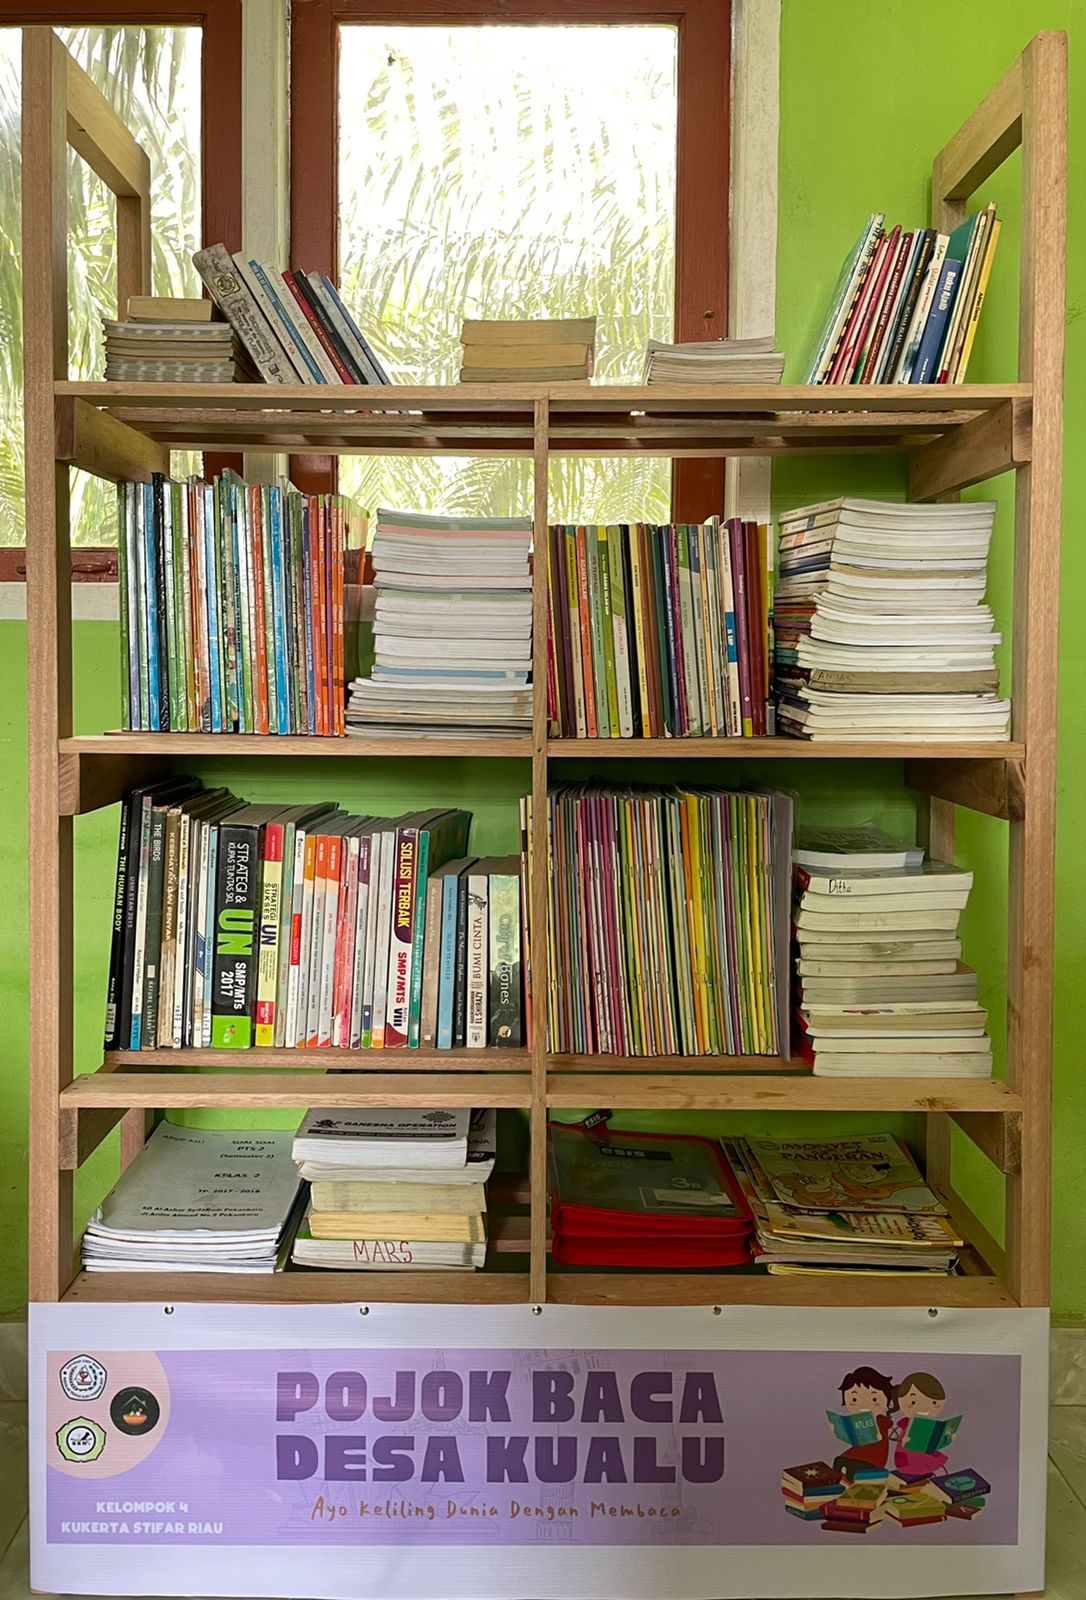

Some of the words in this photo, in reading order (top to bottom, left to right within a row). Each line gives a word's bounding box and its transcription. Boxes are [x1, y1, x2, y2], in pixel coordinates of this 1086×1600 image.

[942, 270, 956, 291] Buku
[936, 290, 951, 311] Ajaib
[153, 824, 162, 838] THE
[152, 839, 162, 862] BIRDS
[168, 832, 176, 881] KESEHATAN
[227, 842, 236, 864] KUPAS
[400, 842, 413, 879] SOLUSI
[118, 856, 127, 873] THE
[235, 843, 249, 892] STRATEGI
[116, 874, 126, 906] HUMAN
[226, 865, 235, 892] TUNTAS
[225, 892, 234, 904] SKL
[235, 894, 247, 904] &
[270, 882, 278, 921] STRATEGI
[397, 882, 411, 928] TERBAIK
[114, 908, 122, 933] BODY
[217, 909, 254, 956] UN
[496, 914, 514, 944] City
[261, 924, 277, 946] UN
[472, 917, 483, 951] CINTA
[395, 952, 407, 1004] SMP/MTS
[472, 952, 482, 980] BUMI
[220, 971, 234, 997] 2017
[233, 962, 247, 1010] SMP/MTs
[500, 964, 512, 1005] Bones
[393, 1007, 403, 1027] VIII
[780, 1151, 885, 1162] PANGERAN
[353, 1240, 414, 1264] MARS
[276, 1371, 512, 1423] POJOK
[532, 1371, 724, 1424] BACA
[855, 1419, 875, 1430] ATLAS
[276, 1435, 465, 1483] DESA
[486, 1436, 725, 1484] KUALU
[96, 1501, 176, 1514] KELOMPOK
[179, 1502, 189, 1514] 4
[312, 1496, 348, 1522] Ayo
[448, 1499, 498, 1520] Dunia
[511, 1500, 579, 1521] Dengan
[591, 1502, 682, 1519] Membaca
[61, 1521, 130, 1534] KUKERTA
[133, 1521, 184, 1534] STIFAR
[187, 1522, 224, 1535] RIAU
